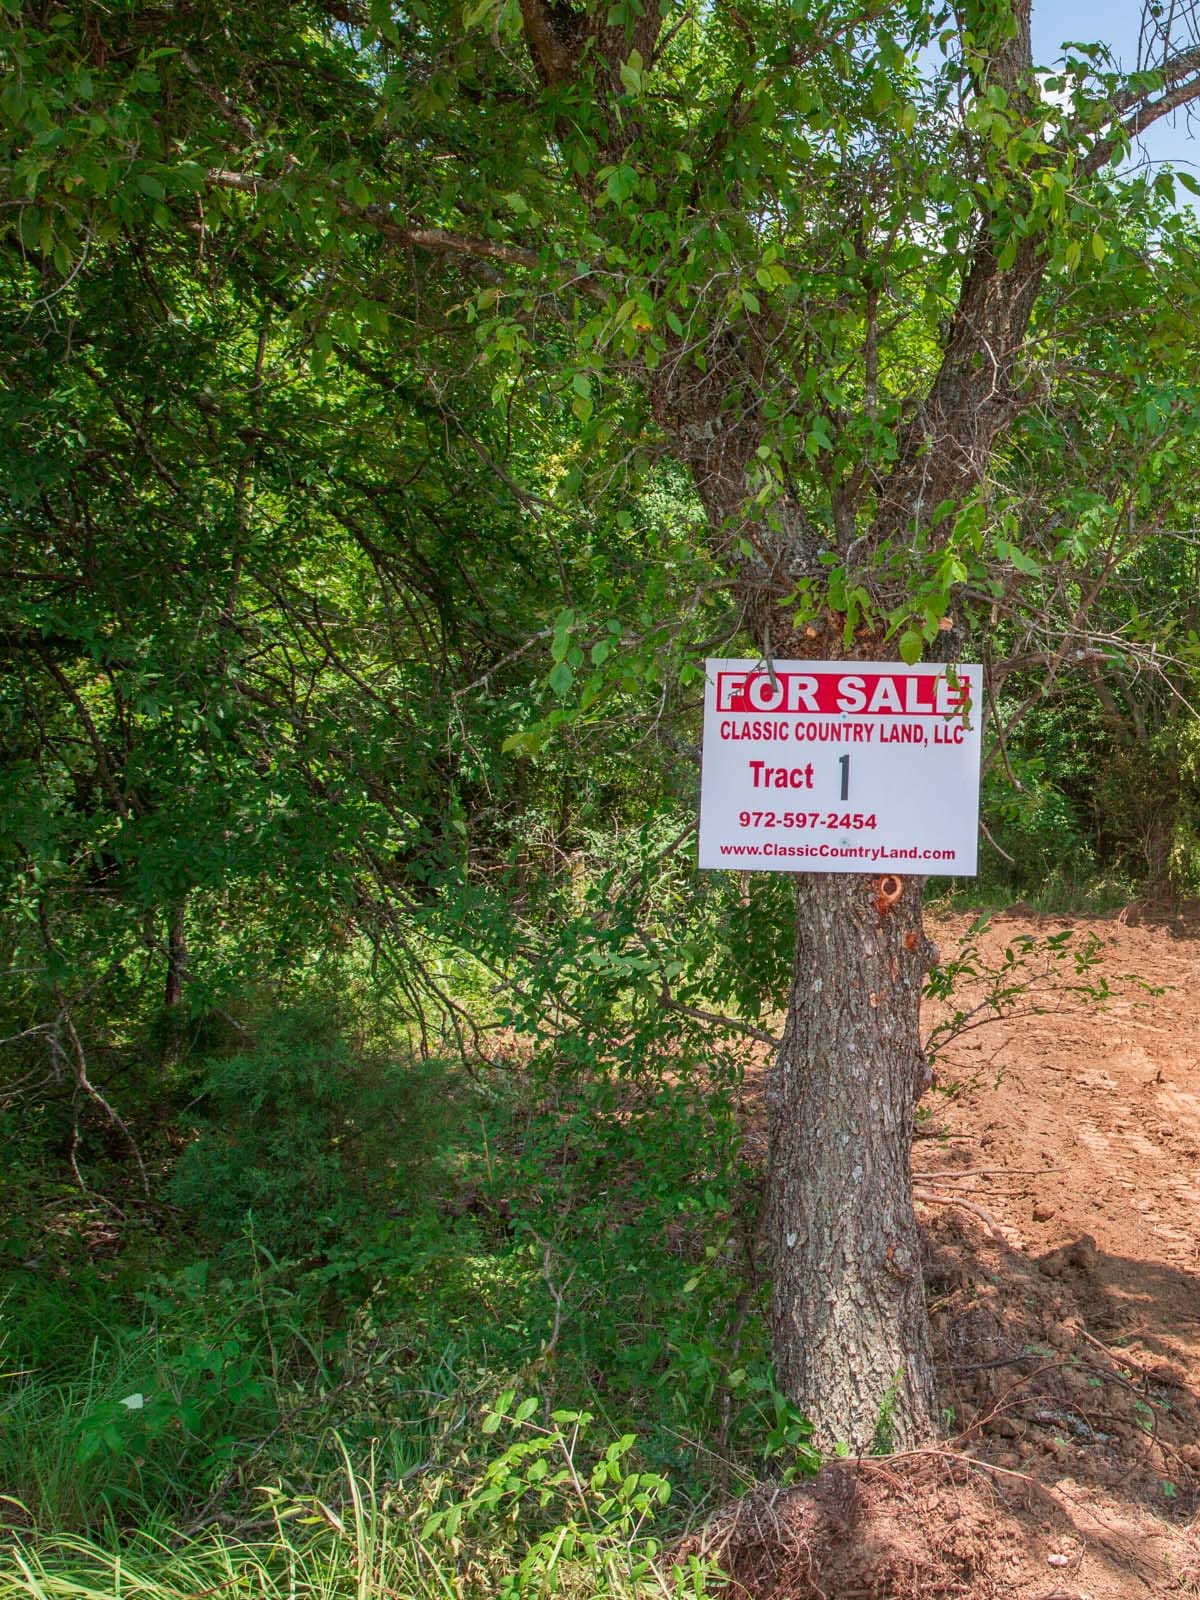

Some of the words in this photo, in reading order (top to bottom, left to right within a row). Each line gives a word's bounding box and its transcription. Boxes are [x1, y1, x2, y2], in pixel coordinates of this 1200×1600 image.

[720, 674, 820, 711] FOR
[837, 676, 971, 713] SALE
[720, 721, 789, 741] CLASSIC
[795, 722, 874, 742] COUNTRY
[880, 724, 928, 748] LAND,
[934, 725, 965, 744] LLC
[749, 761, 814, 788] Tract
[838, 754, 850, 800] 1
[739, 812, 877, 829] 972-597-2454
[720, 843, 956, 861] www.ClassicCountryLand.com
